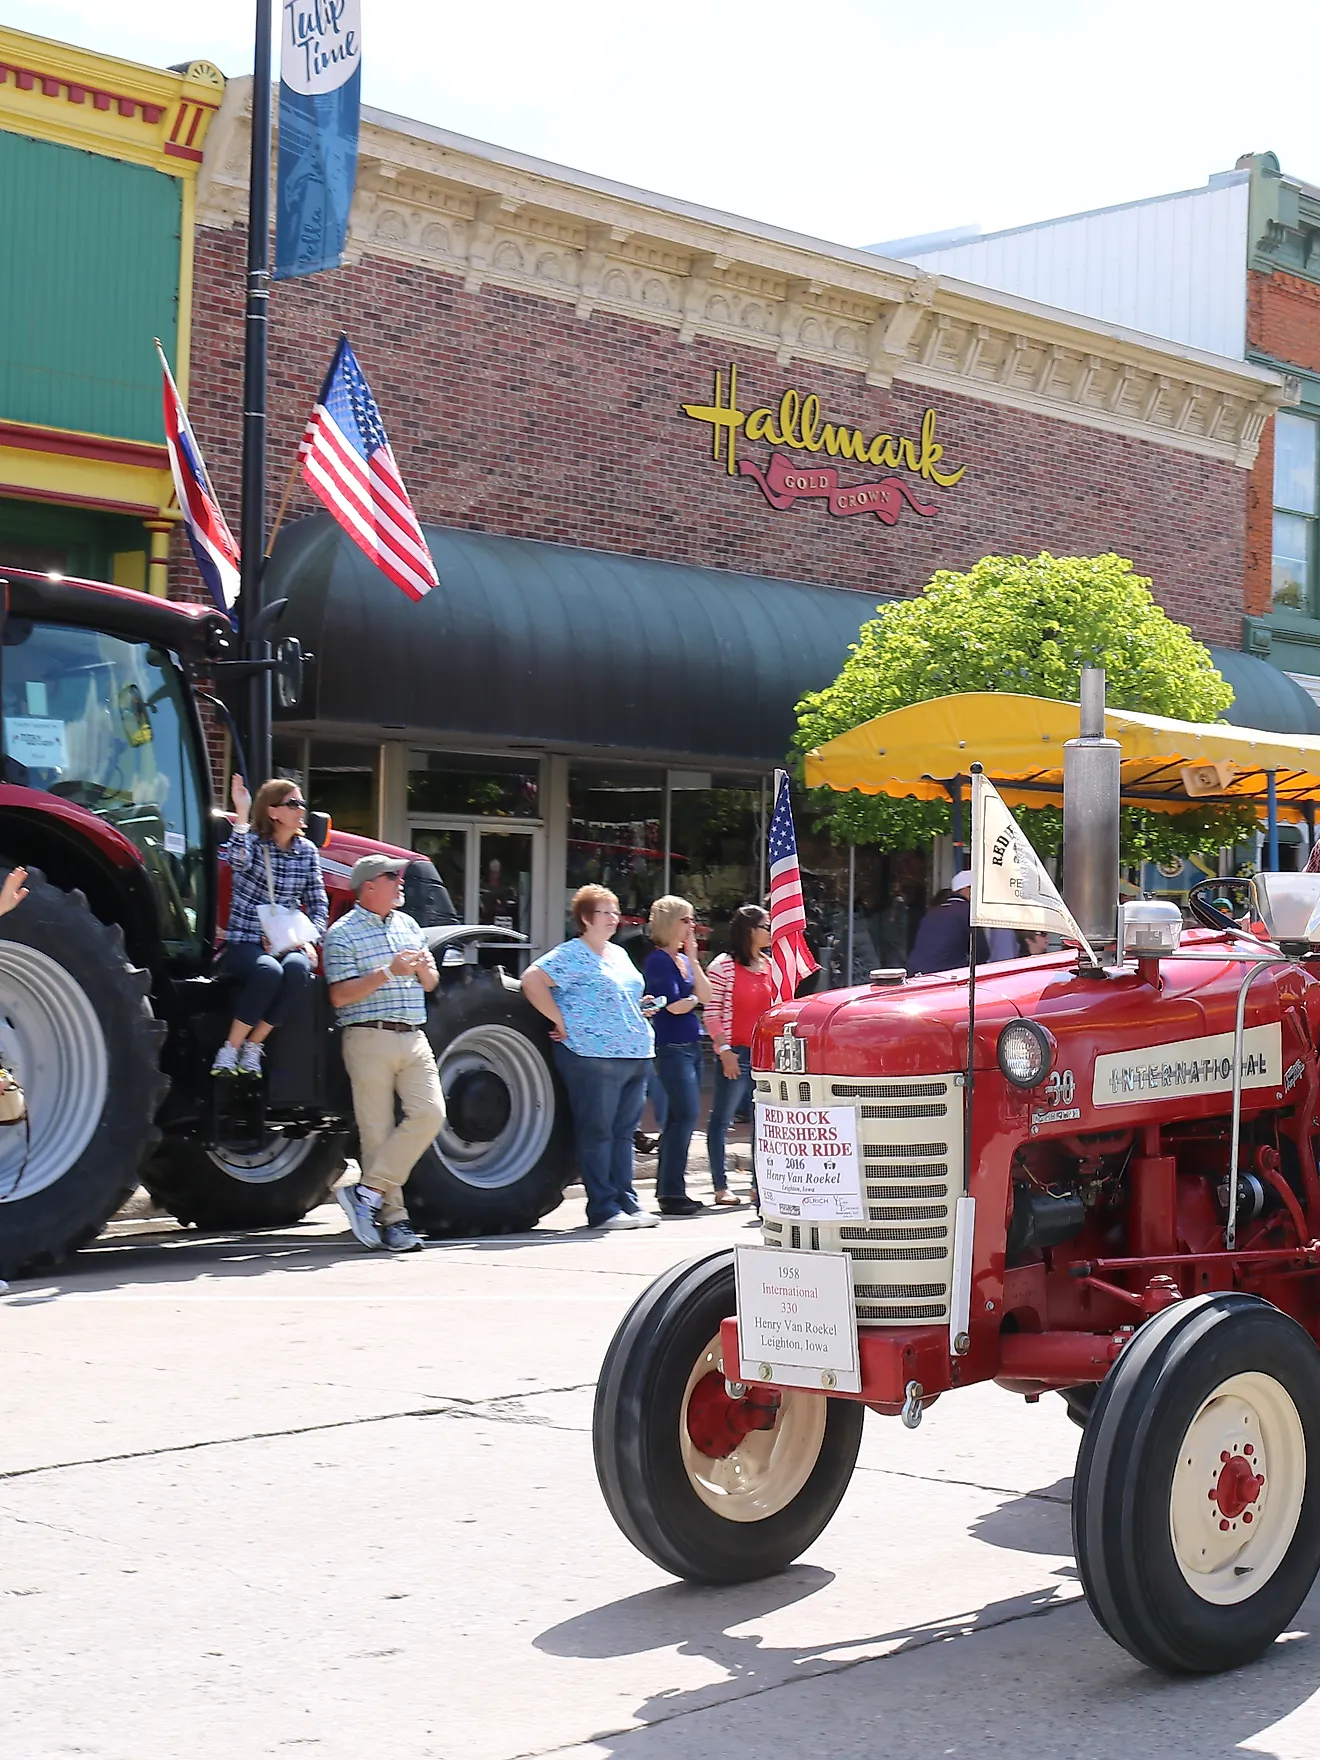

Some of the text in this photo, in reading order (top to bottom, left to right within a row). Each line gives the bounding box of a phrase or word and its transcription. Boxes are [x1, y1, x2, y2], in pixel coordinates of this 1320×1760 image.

[284, 0, 345, 46] Tulip
[297, 30, 359, 82] Time
[680, 362, 967, 488] Hallmark
[784, 474, 829, 491] GOLD
[837, 491, 891, 509] CROWN
[1109, 1052, 1267, 1093] INTERNATIOAL
[765, 1108, 831, 1125] RED ROCK
[763, 1124, 838, 1141] THRESHERS
[758, 1138, 853, 1157] TRACTOR RIDE
[785, 1158, 806, 1170] 2016
[766, 1168, 841, 1184] Henry Van Roekel
[778, 1266, 800, 1280] 1958
[762, 1283, 819, 1299] International
[781, 1302, 798, 1314] 330
[755, 1317, 837, 1336] Henry Van Roekel
[761, 1335, 828, 1352] Leighton, Iowa
